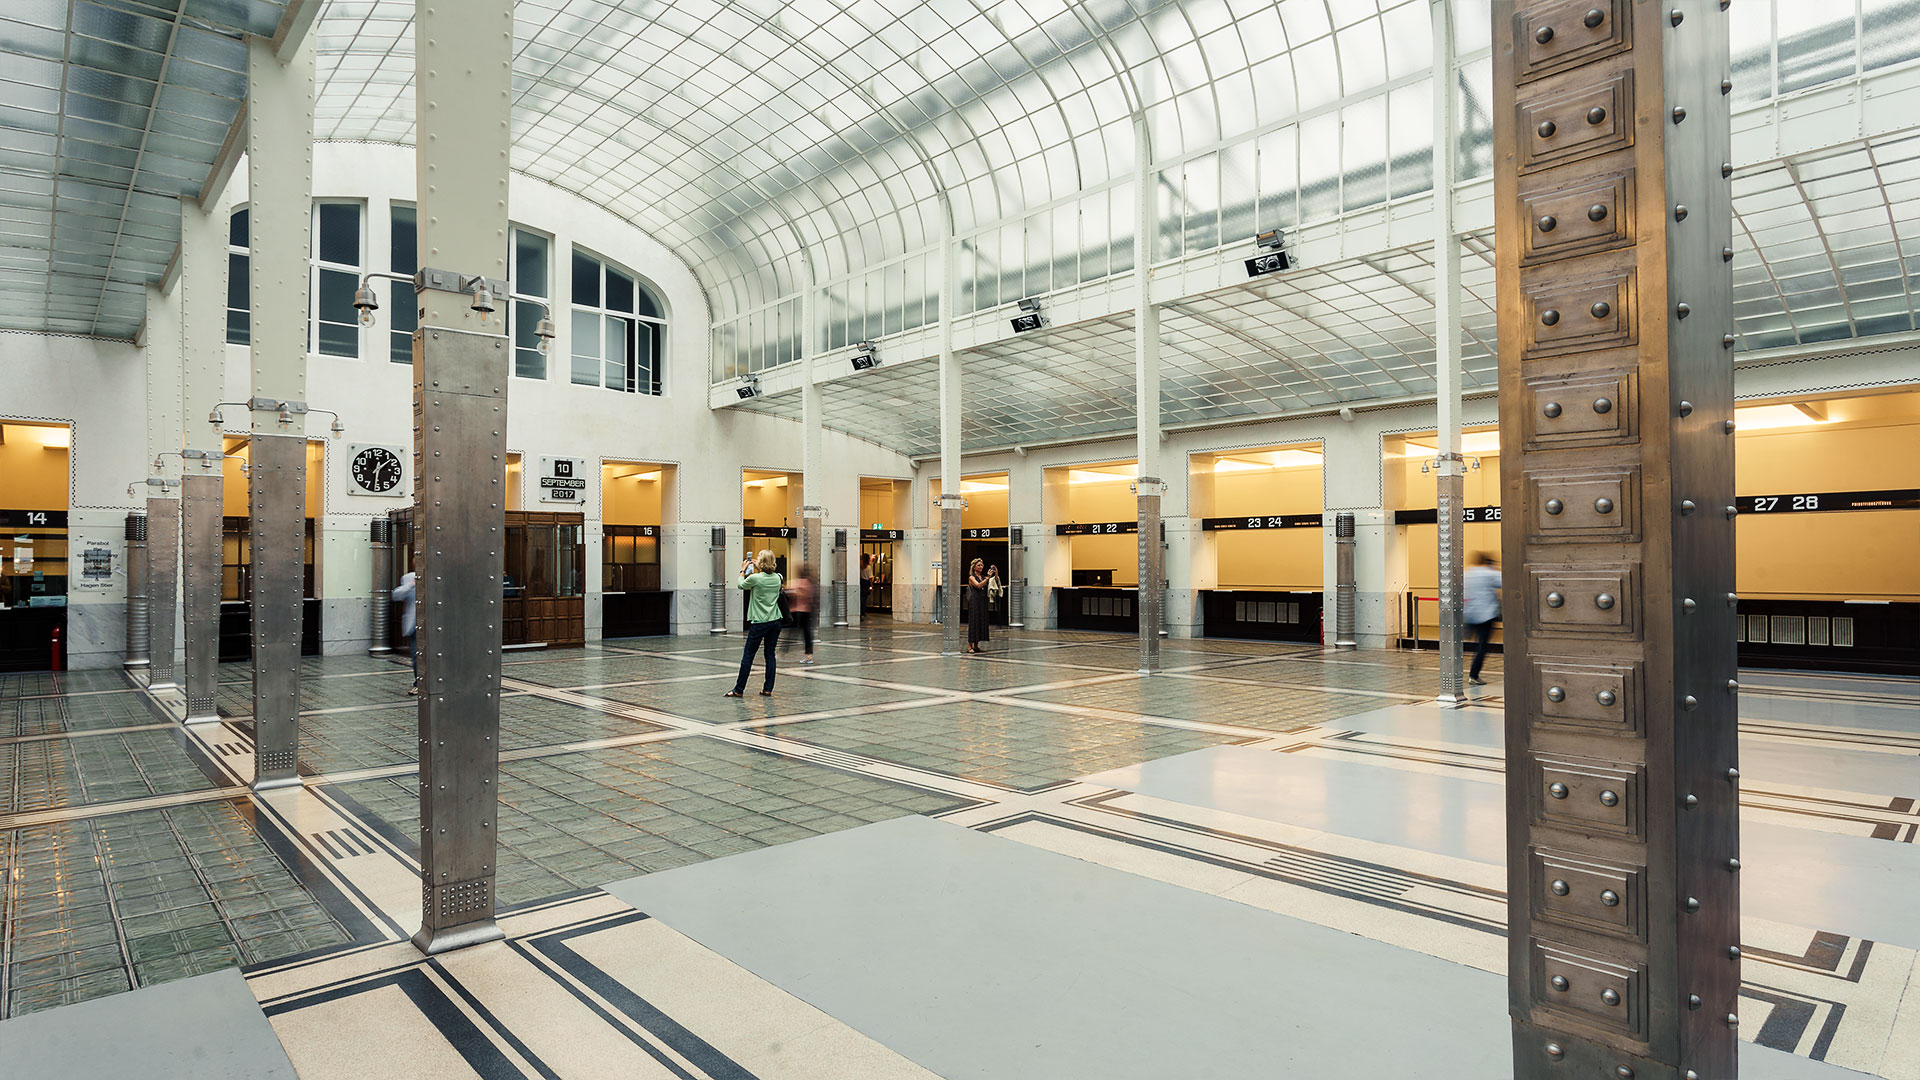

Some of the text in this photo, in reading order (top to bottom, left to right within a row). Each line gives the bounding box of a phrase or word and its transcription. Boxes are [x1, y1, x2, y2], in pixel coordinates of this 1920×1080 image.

[356, 457, 366, 465] 10
[354, 465, 360, 473] 9
[394, 467, 400, 475] 3
[558, 464, 569, 473] 10
[384, 481, 389, 489] 5
[542, 479, 584, 488] SEPTEMBER
[553, 490, 574, 498] 2017
[1754, 496, 1818, 511] 27 28
[27, 512, 47, 524] 14
[1485, 508, 1501, 520] 26
[1248, 517, 1282, 528] 23 24
[643, 527, 652, 535] 16
[781, 528, 789, 536] 17
[1092, 524, 1117, 533] 21 22
[970, 529, 990, 538] 19 20
